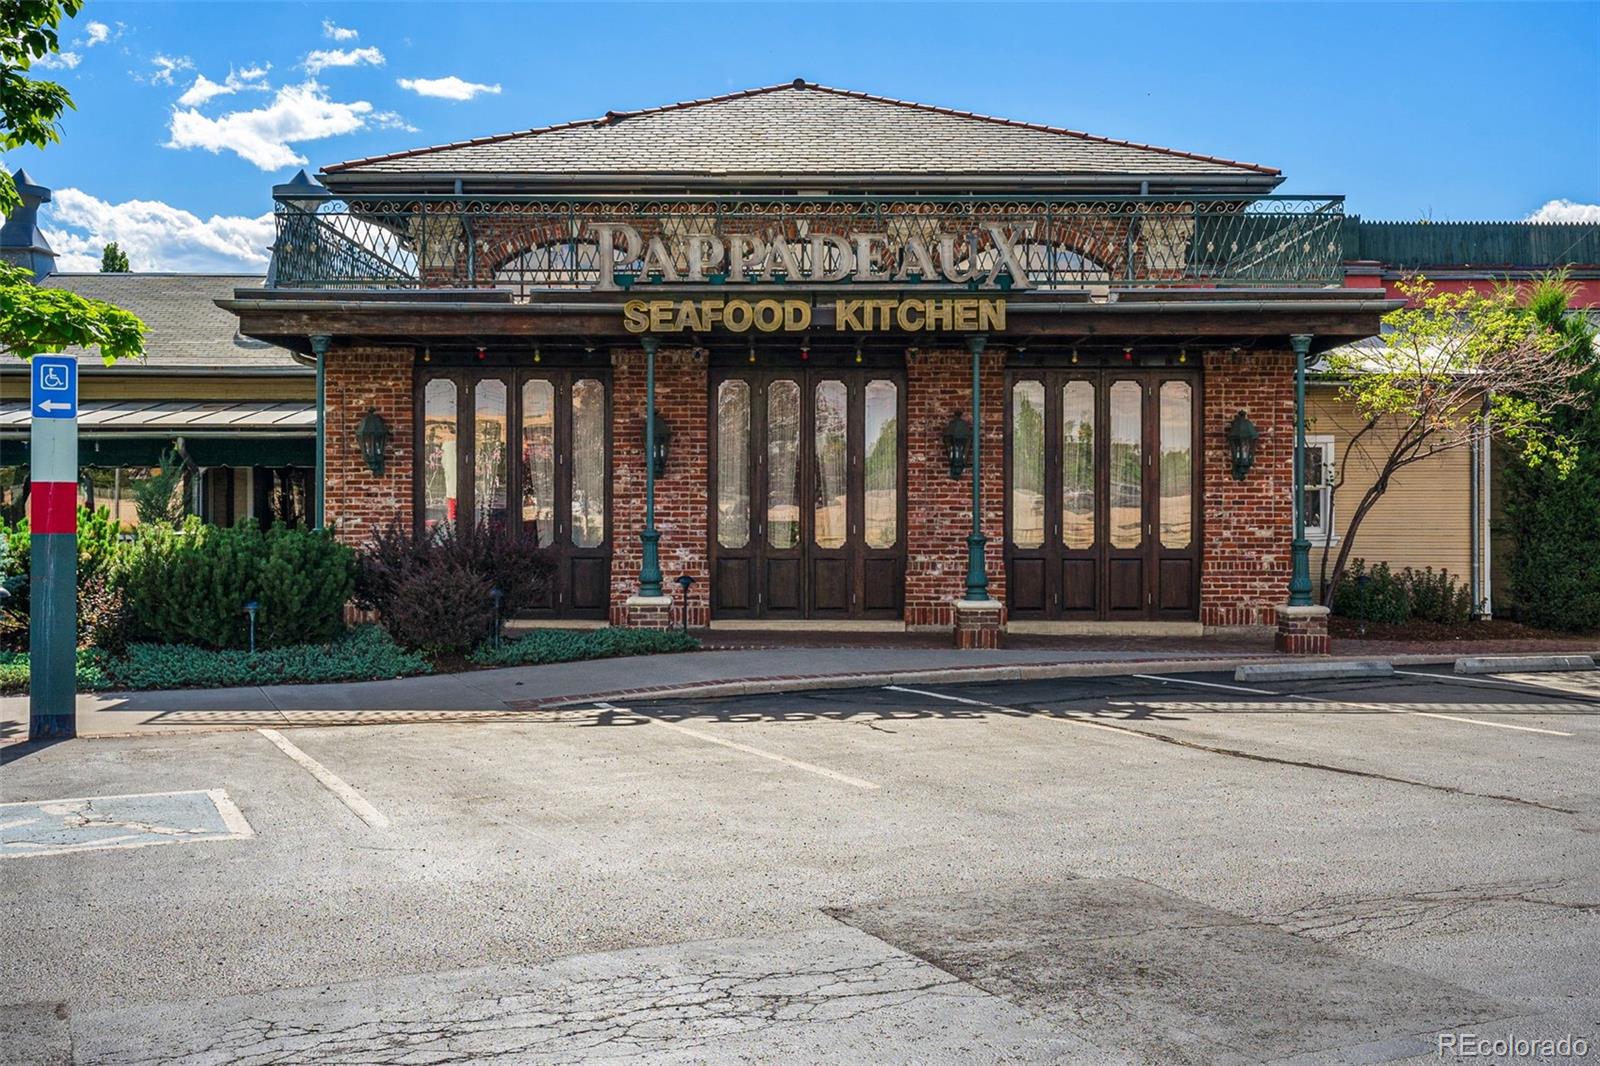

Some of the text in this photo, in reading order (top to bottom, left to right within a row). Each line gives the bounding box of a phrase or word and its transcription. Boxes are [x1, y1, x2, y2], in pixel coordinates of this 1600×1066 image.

[588, 222, 1037, 291] PAPPADEAUX
[623, 299, 1007, 333] SEAFOOD KITCHEN
